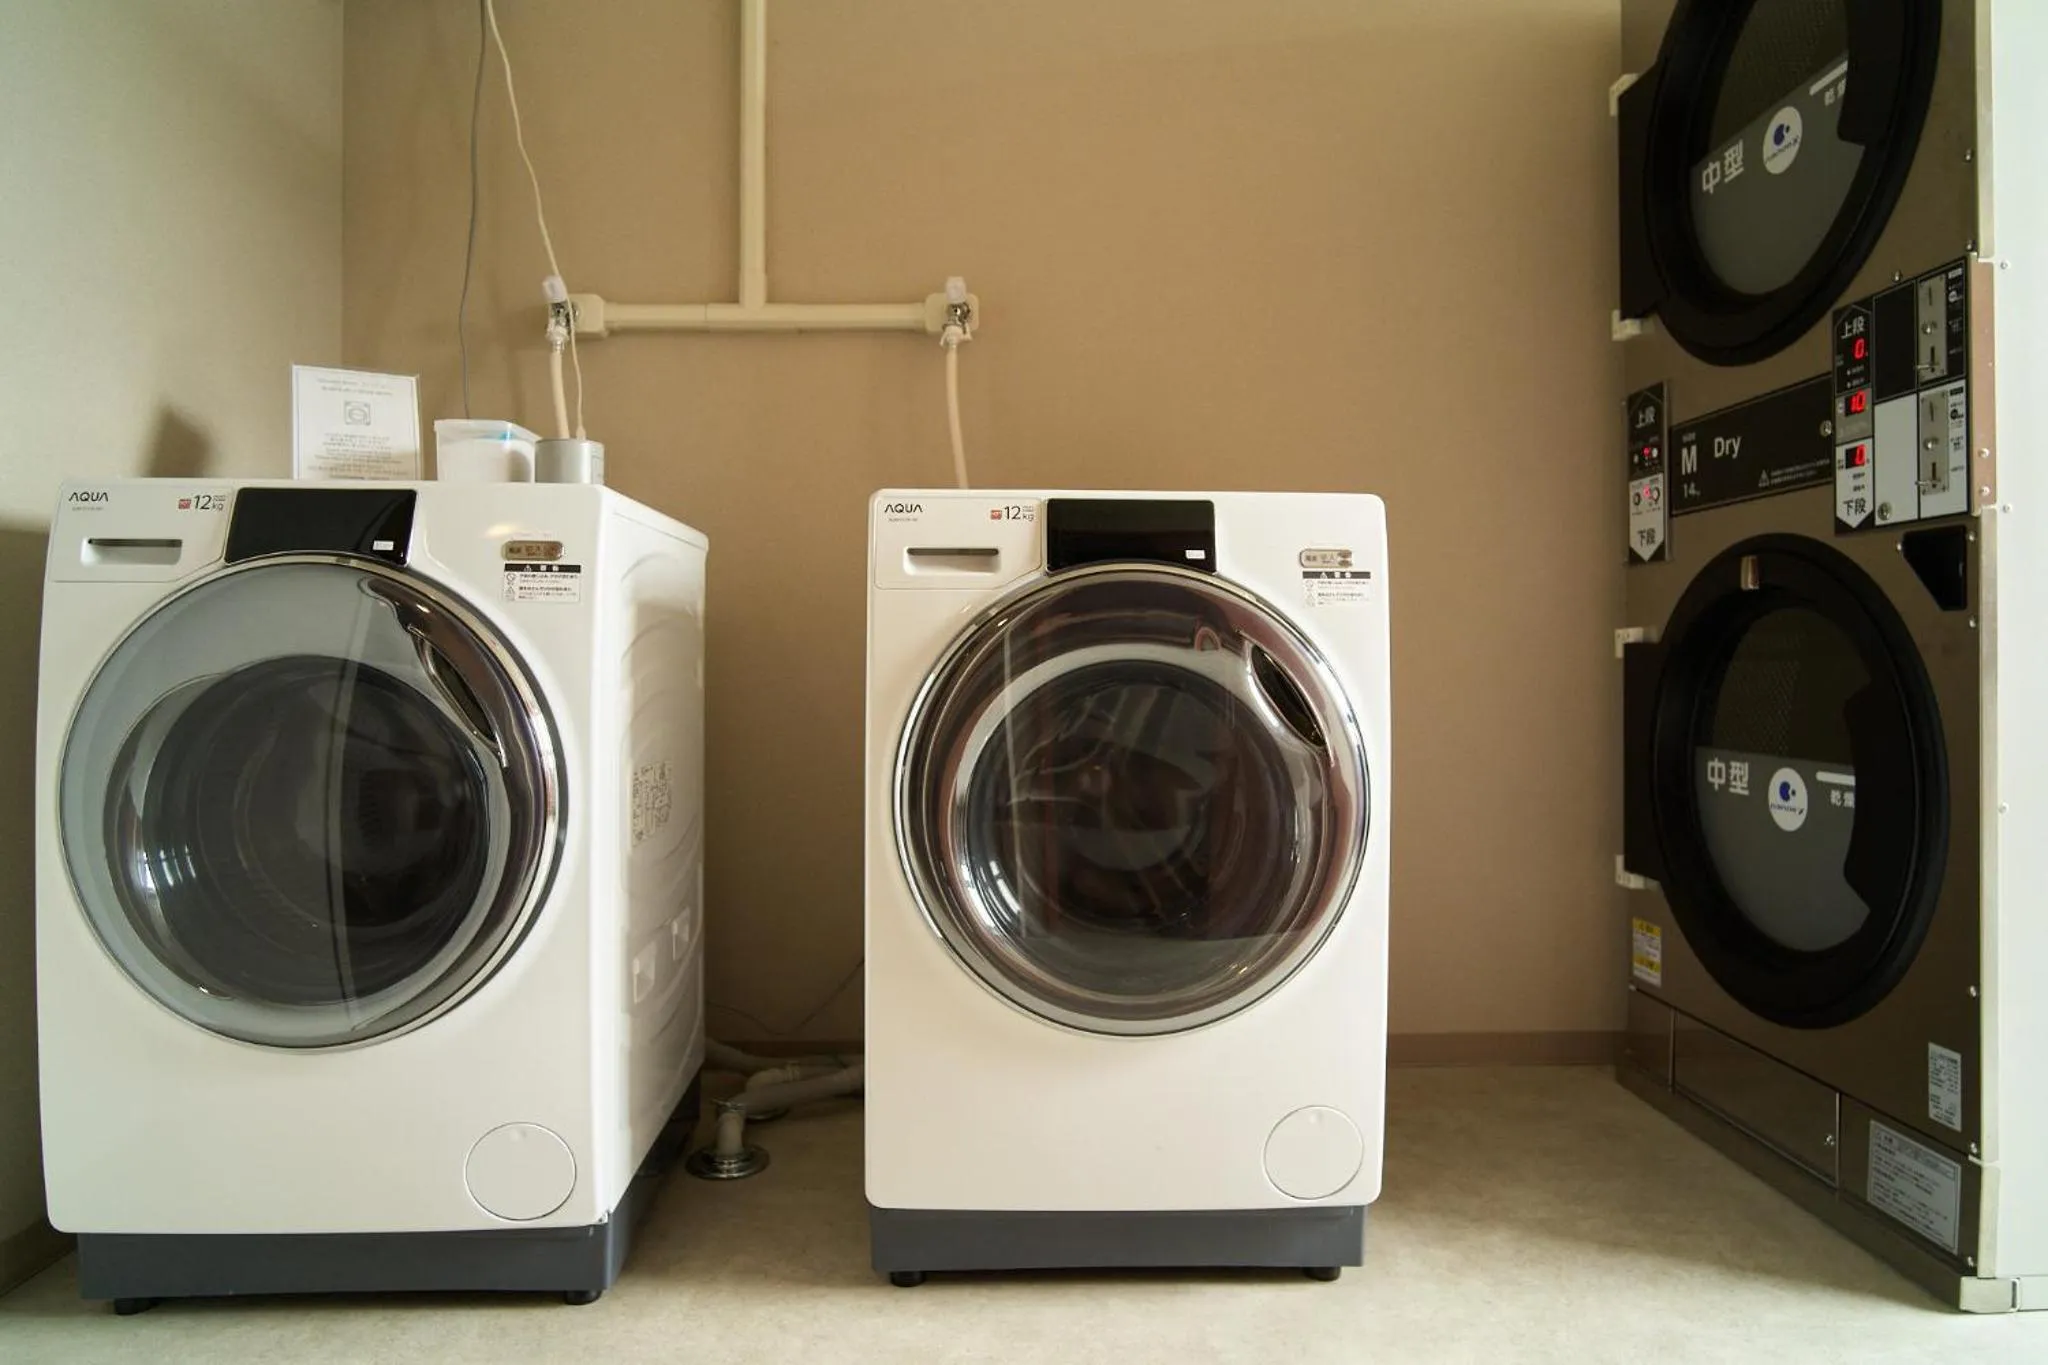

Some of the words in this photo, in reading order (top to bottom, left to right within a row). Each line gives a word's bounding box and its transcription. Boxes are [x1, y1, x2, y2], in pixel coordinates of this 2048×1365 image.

[1702, 139, 1744, 194] 中型
[1841, 315, 1864, 339] 上段
[1854, 338, 1865, 360] 0
[1714, 436, 1742, 459] Dry
[1681, 444, 1697, 475] M
[68, 491, 109, 502] AQUA
[194, 494, 212, 510] 12
[1843, 497, 1866, 516] 下段
[884, 503, 923, 514] AQUA
[1004, 505, 1021, 520] 12
[1637, 527, 1656, 547] 下段
[1707, 757, 1749, 796] 中型
